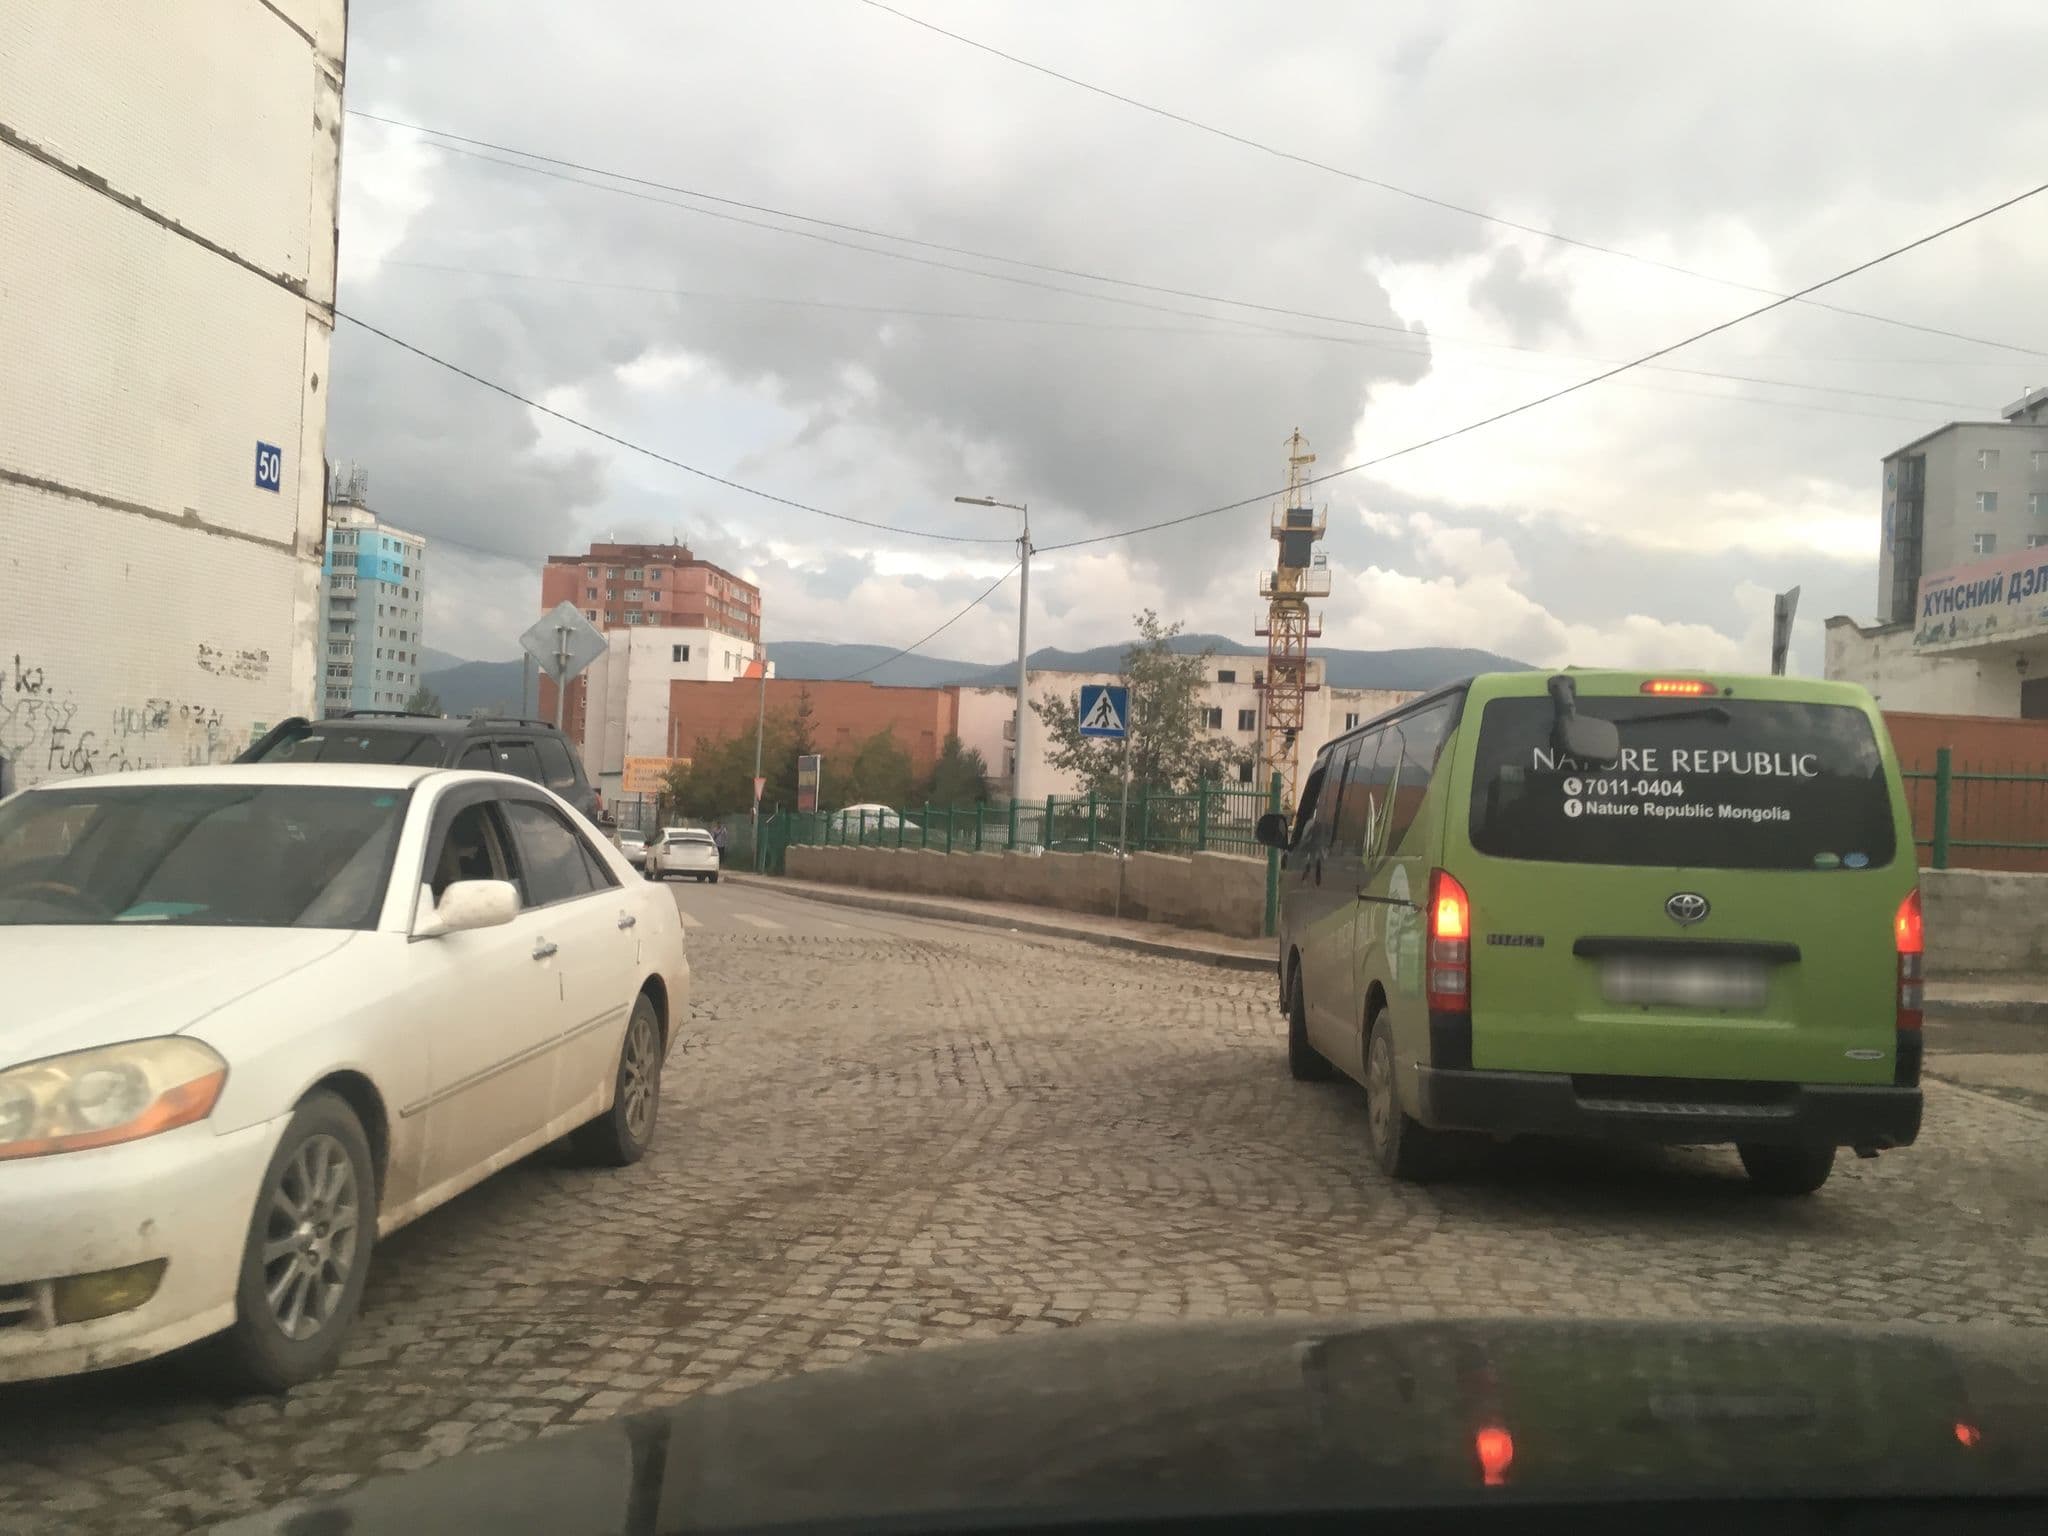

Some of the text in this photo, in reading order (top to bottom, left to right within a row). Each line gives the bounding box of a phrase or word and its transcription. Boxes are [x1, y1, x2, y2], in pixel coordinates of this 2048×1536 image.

[259, 451, 279, 483] 50
[1533, 747, 1819, 778] NARE REPUBLIC
[1585, 779, 1684, 797] 7011-0404
[1586, 801, 1791, 823] Nature Republic Mongolia
